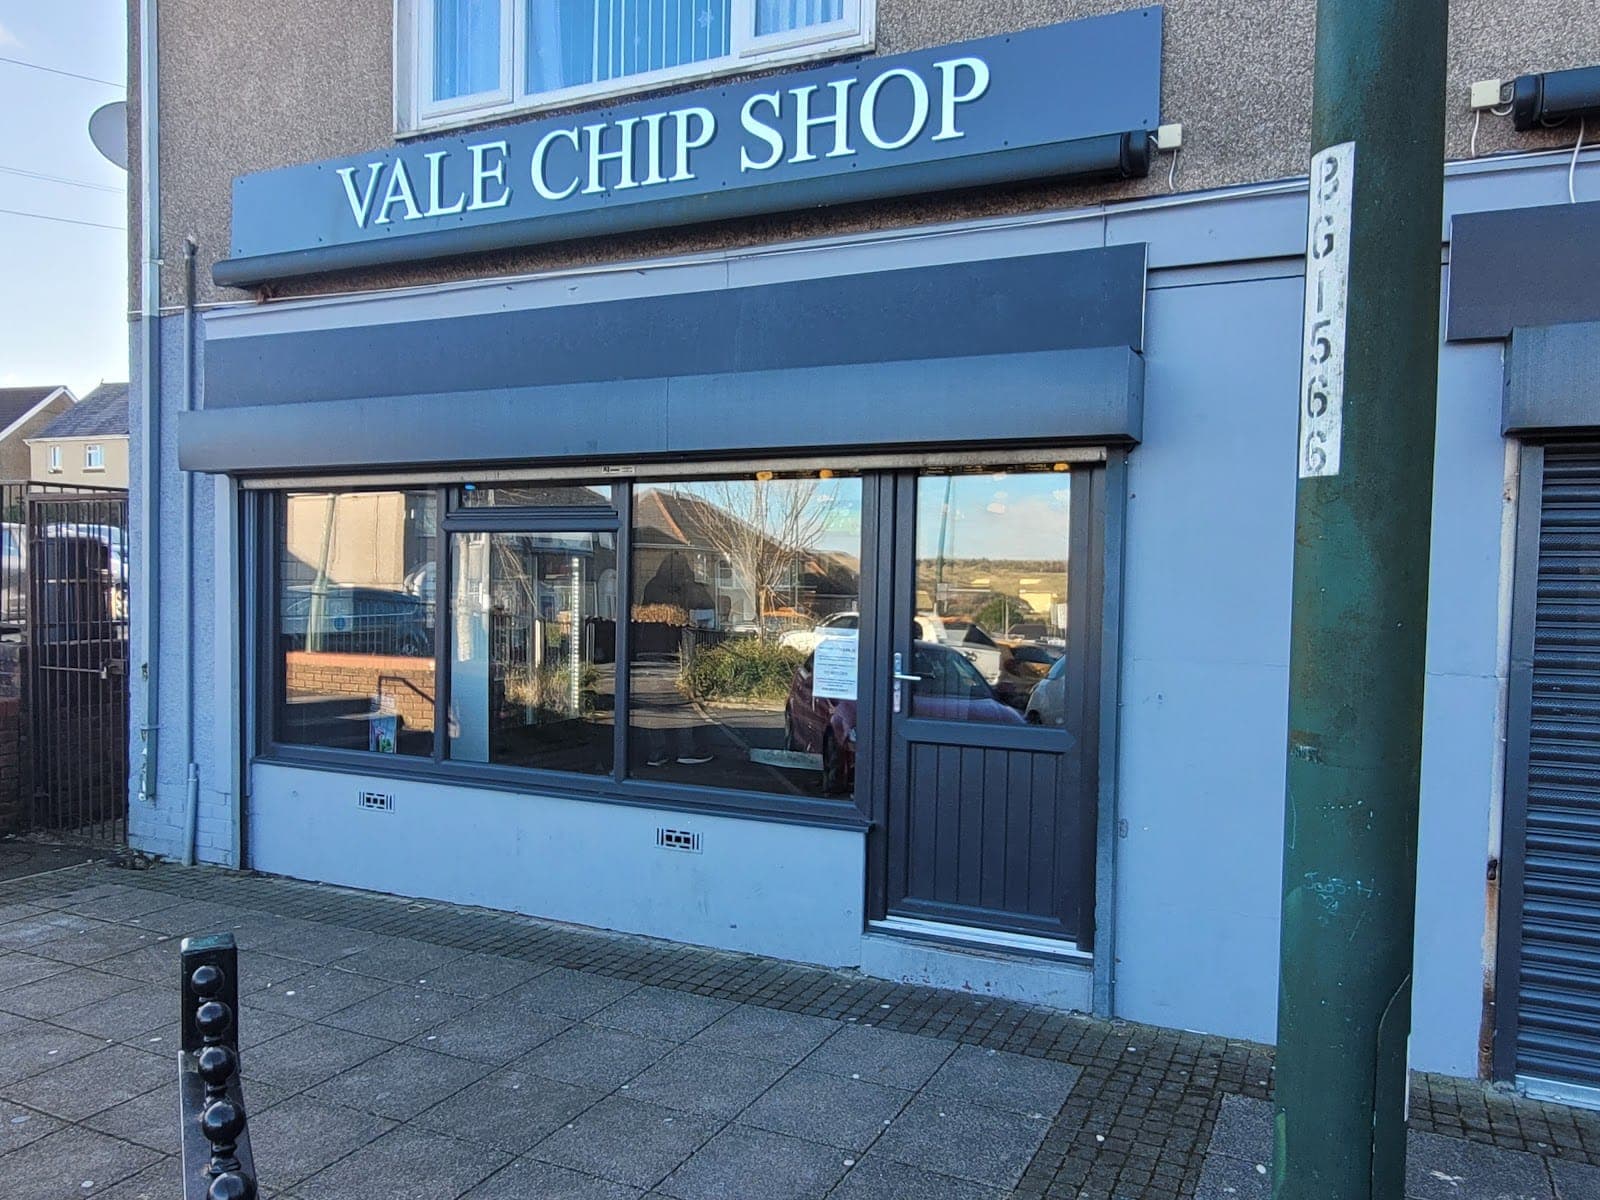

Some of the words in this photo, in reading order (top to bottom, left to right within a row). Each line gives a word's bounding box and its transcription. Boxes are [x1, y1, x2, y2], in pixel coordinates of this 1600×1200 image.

[336, 140, 511, 228] VALE
[531, 107, 716, 200] CHIP
[740, 56, 990, 174] SHOP
